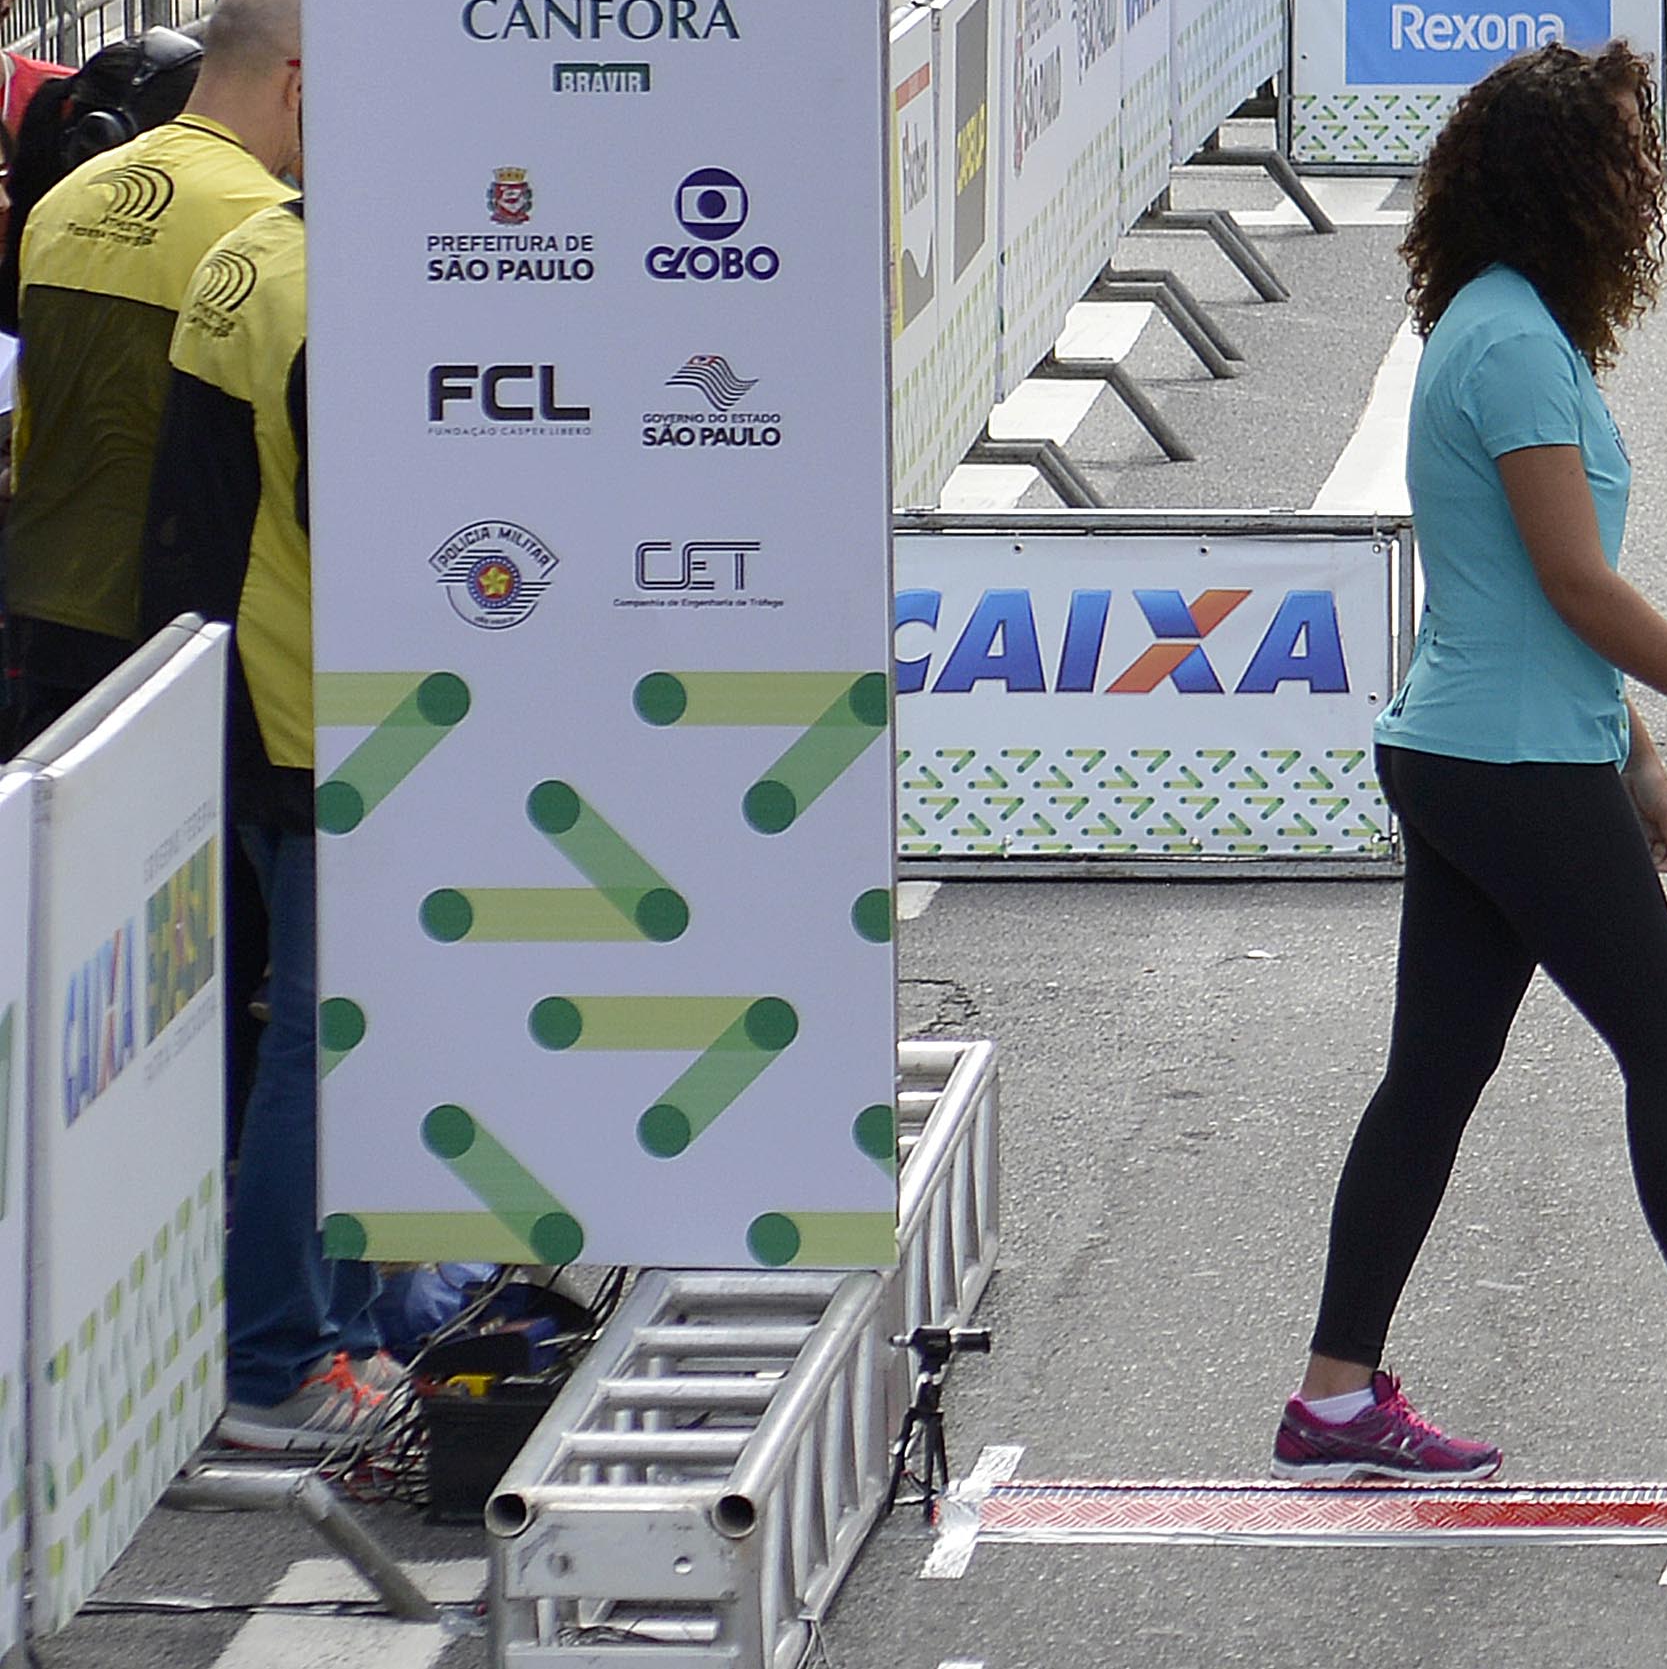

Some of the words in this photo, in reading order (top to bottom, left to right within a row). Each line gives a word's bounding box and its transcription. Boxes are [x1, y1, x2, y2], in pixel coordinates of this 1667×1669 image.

[1392, 4, 1565, 51] Rexona
[560, 71, 642, 92] BRAVIR
[427, 235, 557, 253] PREFEITURA
[566, 235, 593, 252] DE
[427, 255, 488, 281] SÃO
[497, 259, 593, 281] PAULO
[646, 246, 779, 280] GLOBO
[428, 364, 590, 421] FCL
[642, 414, 705, 424] GOVERNO
[708, 414, 728, 424] DO
[731, 414, 781, 424] ESTADO
[642, 424, 695, 447] SÃO
[700, 427, 781, 447] PAULO
[498, 527, 550, 567] MILITAR
[635, 542, 761, 590] CET
[895, 589, 1350, 694] CAIXA
[63, 917, 135, 1129] CAIXA
